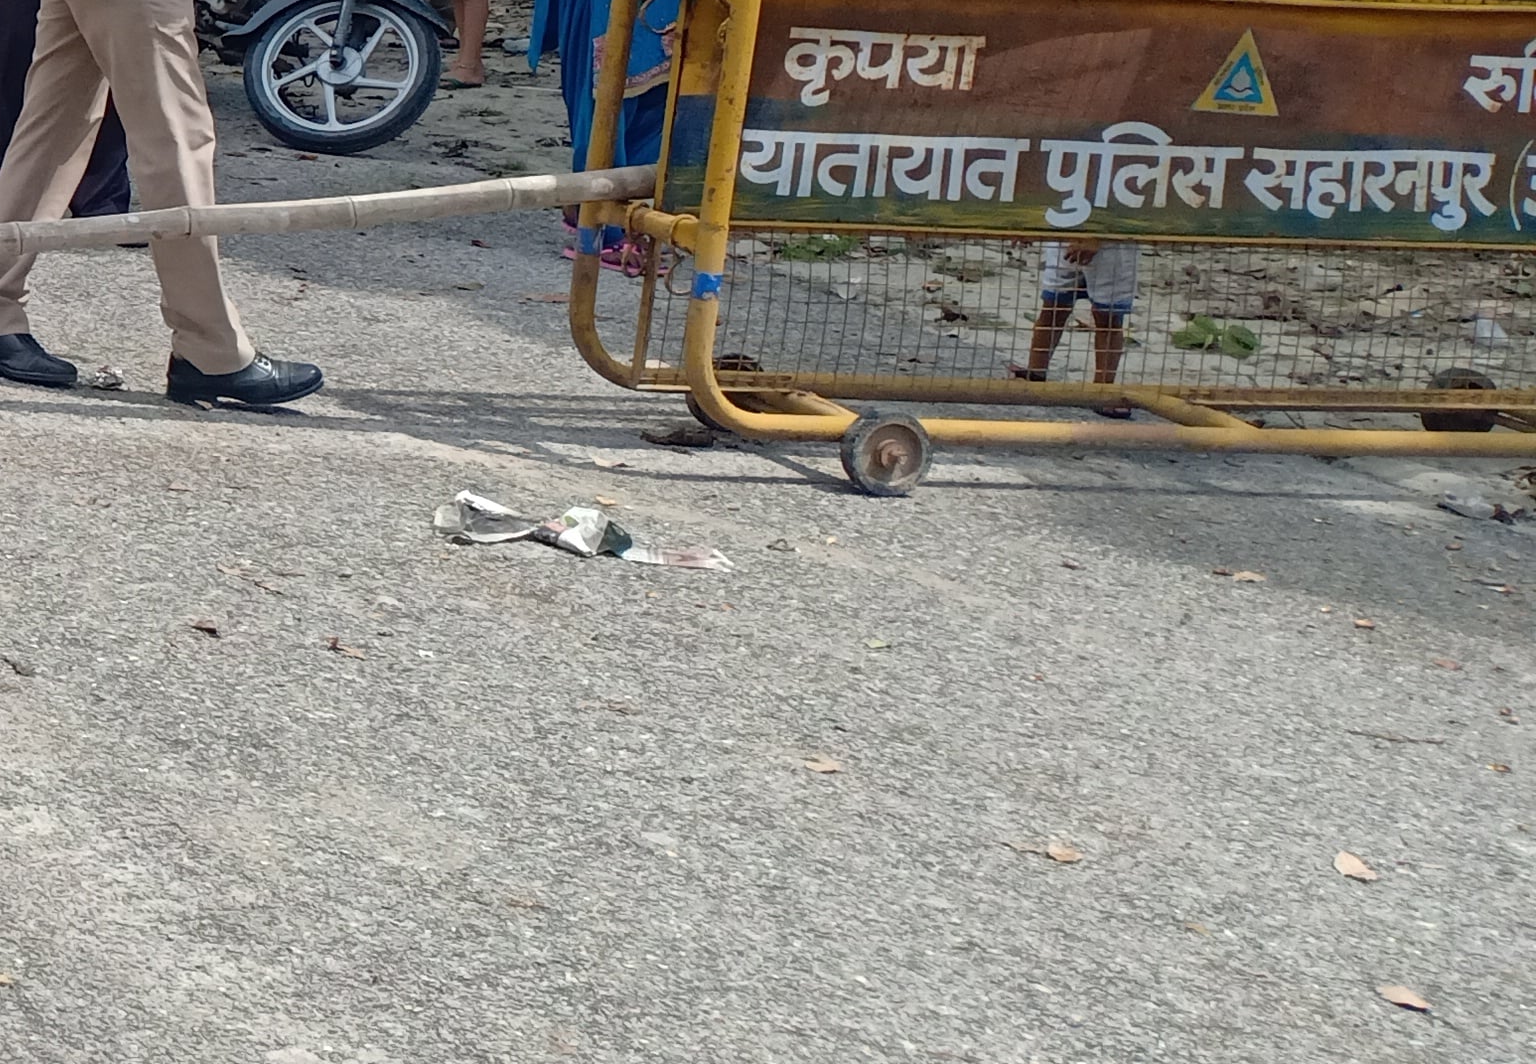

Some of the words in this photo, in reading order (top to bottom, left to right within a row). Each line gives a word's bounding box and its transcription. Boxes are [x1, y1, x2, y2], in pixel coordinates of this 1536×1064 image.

[784, 26, 987, 107] कृपया
[740, 128, 1031, 203] यातायात
[1040, 121, 1245, 228] पुलिस
[1244, 147, 1497, 231] सहारनपुर
